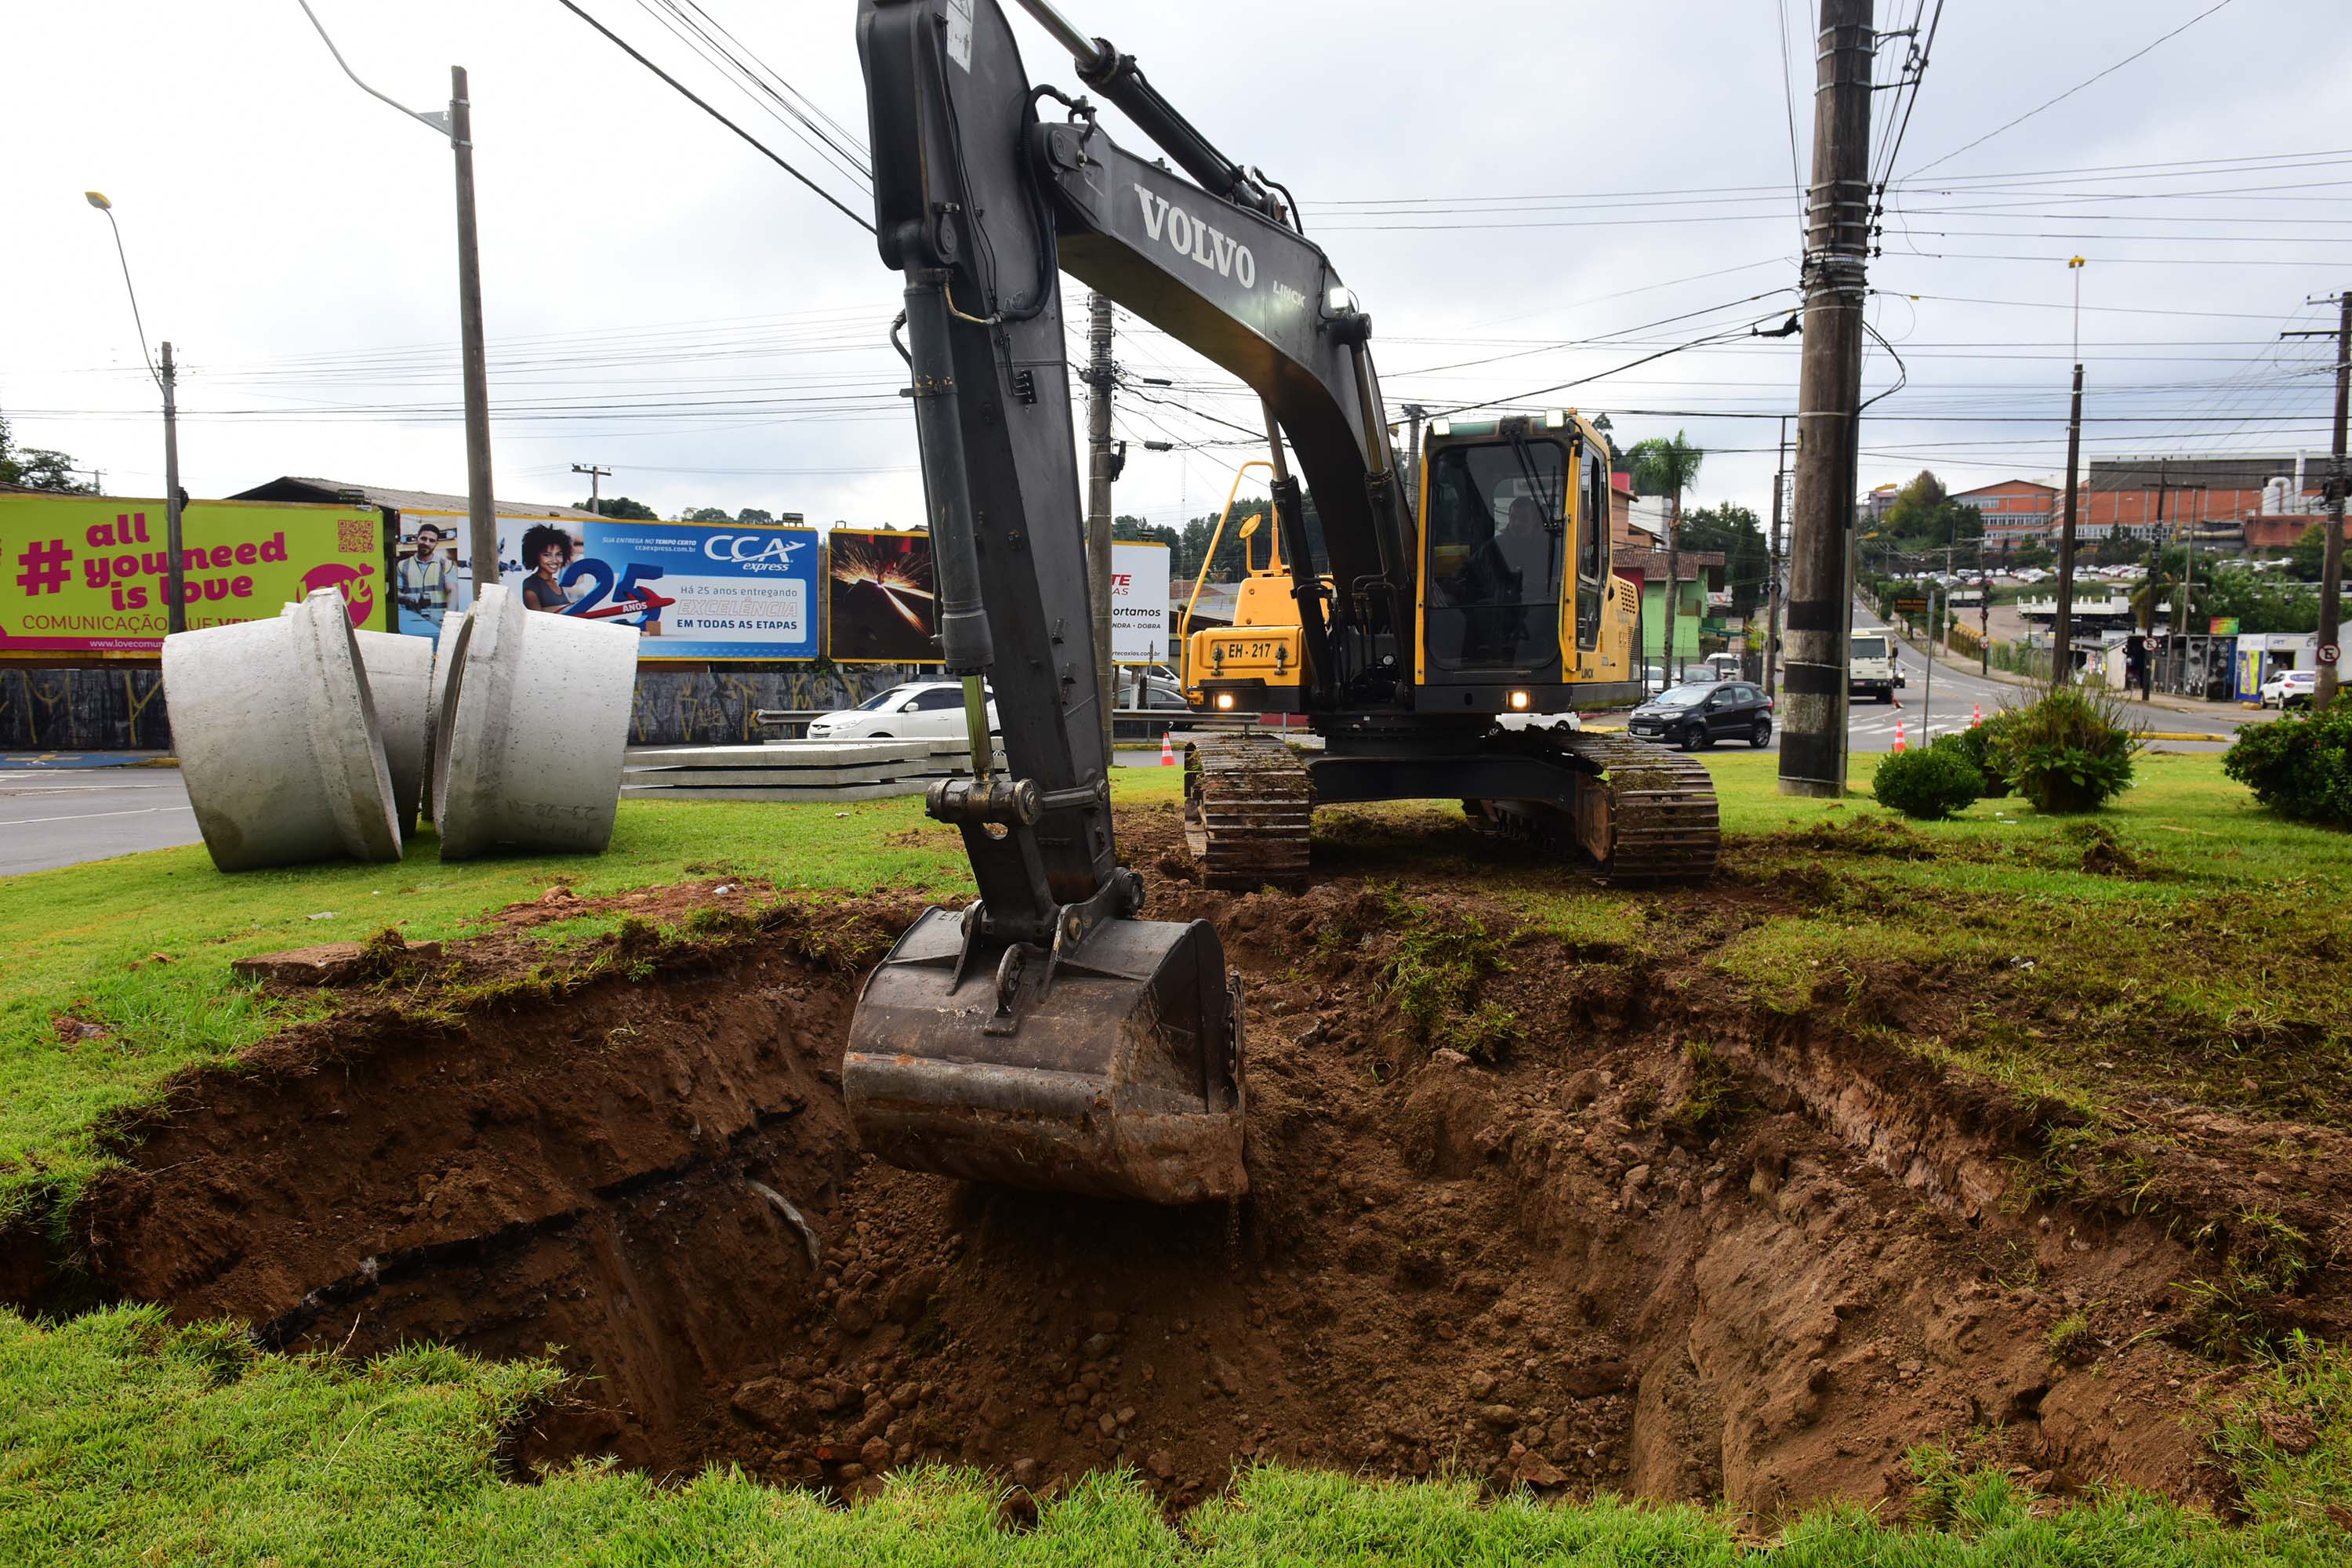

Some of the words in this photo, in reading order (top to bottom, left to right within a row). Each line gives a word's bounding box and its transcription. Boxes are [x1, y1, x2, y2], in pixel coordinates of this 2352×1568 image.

[1134, 183, 1255, 289] VOLVO
[1273, 280, 1305, 307] LINCK
[85, 513, 150, 547] all
[704, 535, 790, 563] CCA
[84, 552, 168, 588] you
[181, 532, 288, 571] need
[742, 562, 789, 572] express
[111, 579, 148, 611] is
[681, 586, 693, 594] Há
[741, 588, 797, 597] entregando
[622, 601, 648, 613] ANOS
[677, 597, 797, 617] EXCELÊNCIA
[22, 614, 169, 633] COMUNICAÇÃO
[677, 619, 693, 628] EM
[697, 619, 735, 629] TODAS
[739, 621, 753, 630] AS
[757, 621, 797, 630] ETAPAS
[1229, 644, 1243, 658] EH
[1252, 644, 1271, 659] 217
